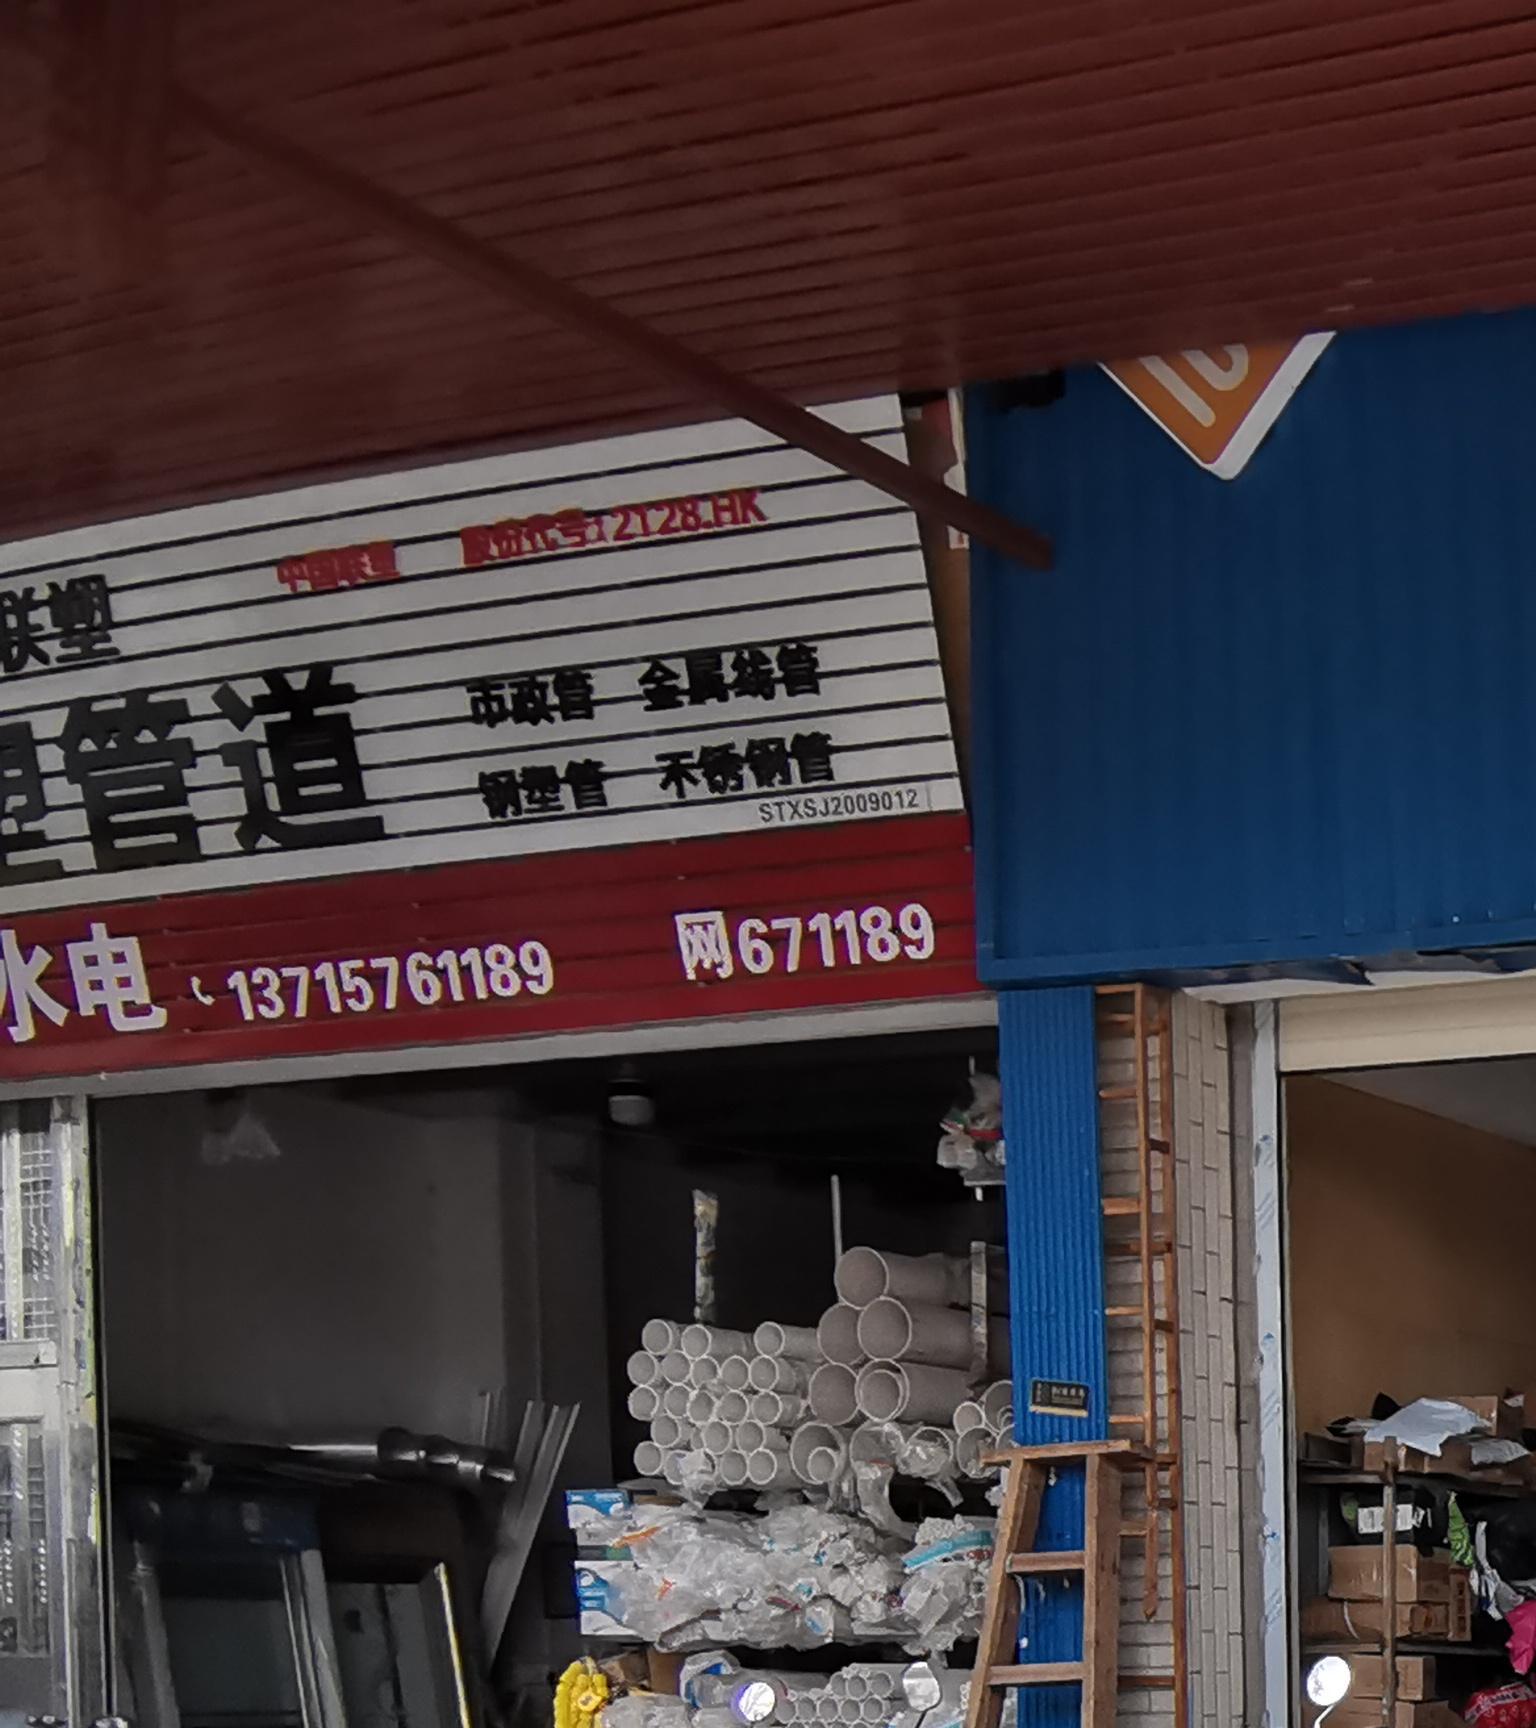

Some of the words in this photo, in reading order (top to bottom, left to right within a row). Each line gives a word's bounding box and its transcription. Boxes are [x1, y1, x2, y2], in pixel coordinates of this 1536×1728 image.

[466, 670, 595, 727] 市政管
[655, 731, 835, 799] 不锈钢管
[759, 789, 919, 823] STXSJ2009012
[0, 922, 168, 1045] 水电
[227, 941, 555, 1023] 13715761189
